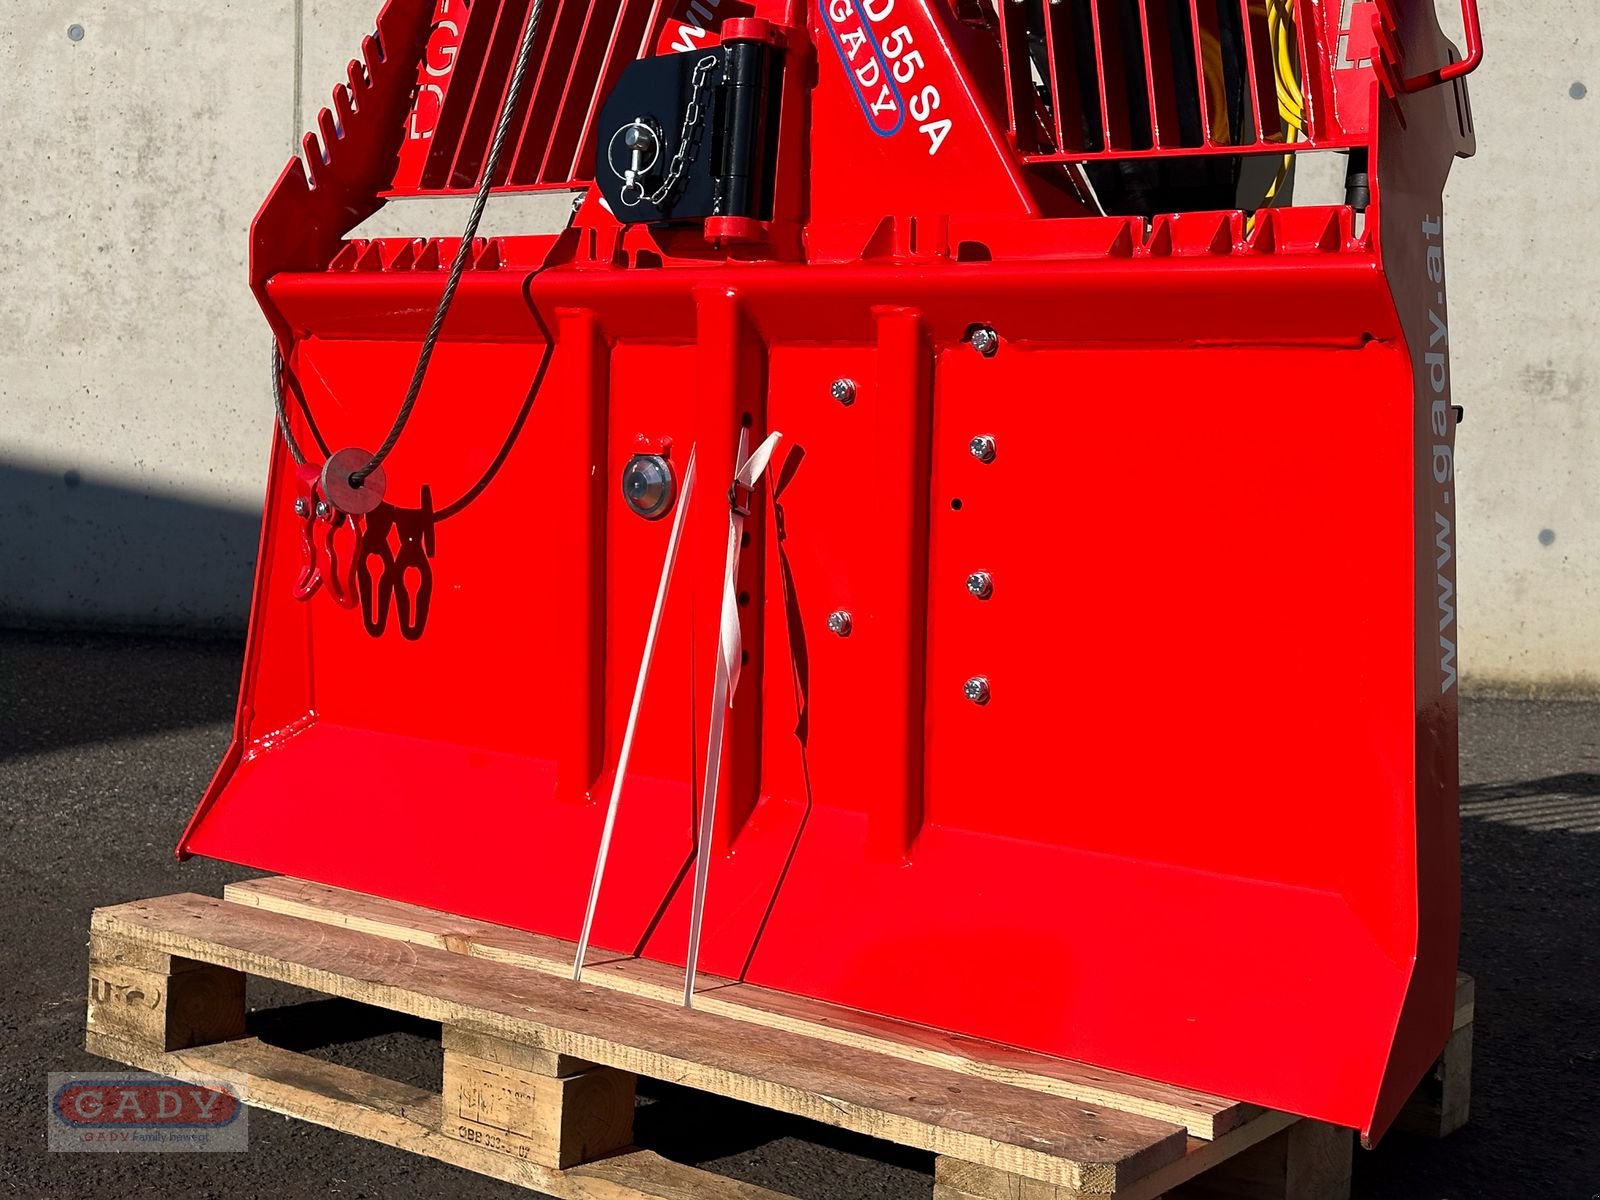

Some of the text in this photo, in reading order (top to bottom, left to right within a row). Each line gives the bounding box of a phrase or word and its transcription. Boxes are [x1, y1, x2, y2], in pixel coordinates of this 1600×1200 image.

[829, 0, 897, 117] GADY
[881, 25, 925, 84] 55
[909, 85, 953, 156] SA
[1422, 213, 1457, 694] www.gady.at
